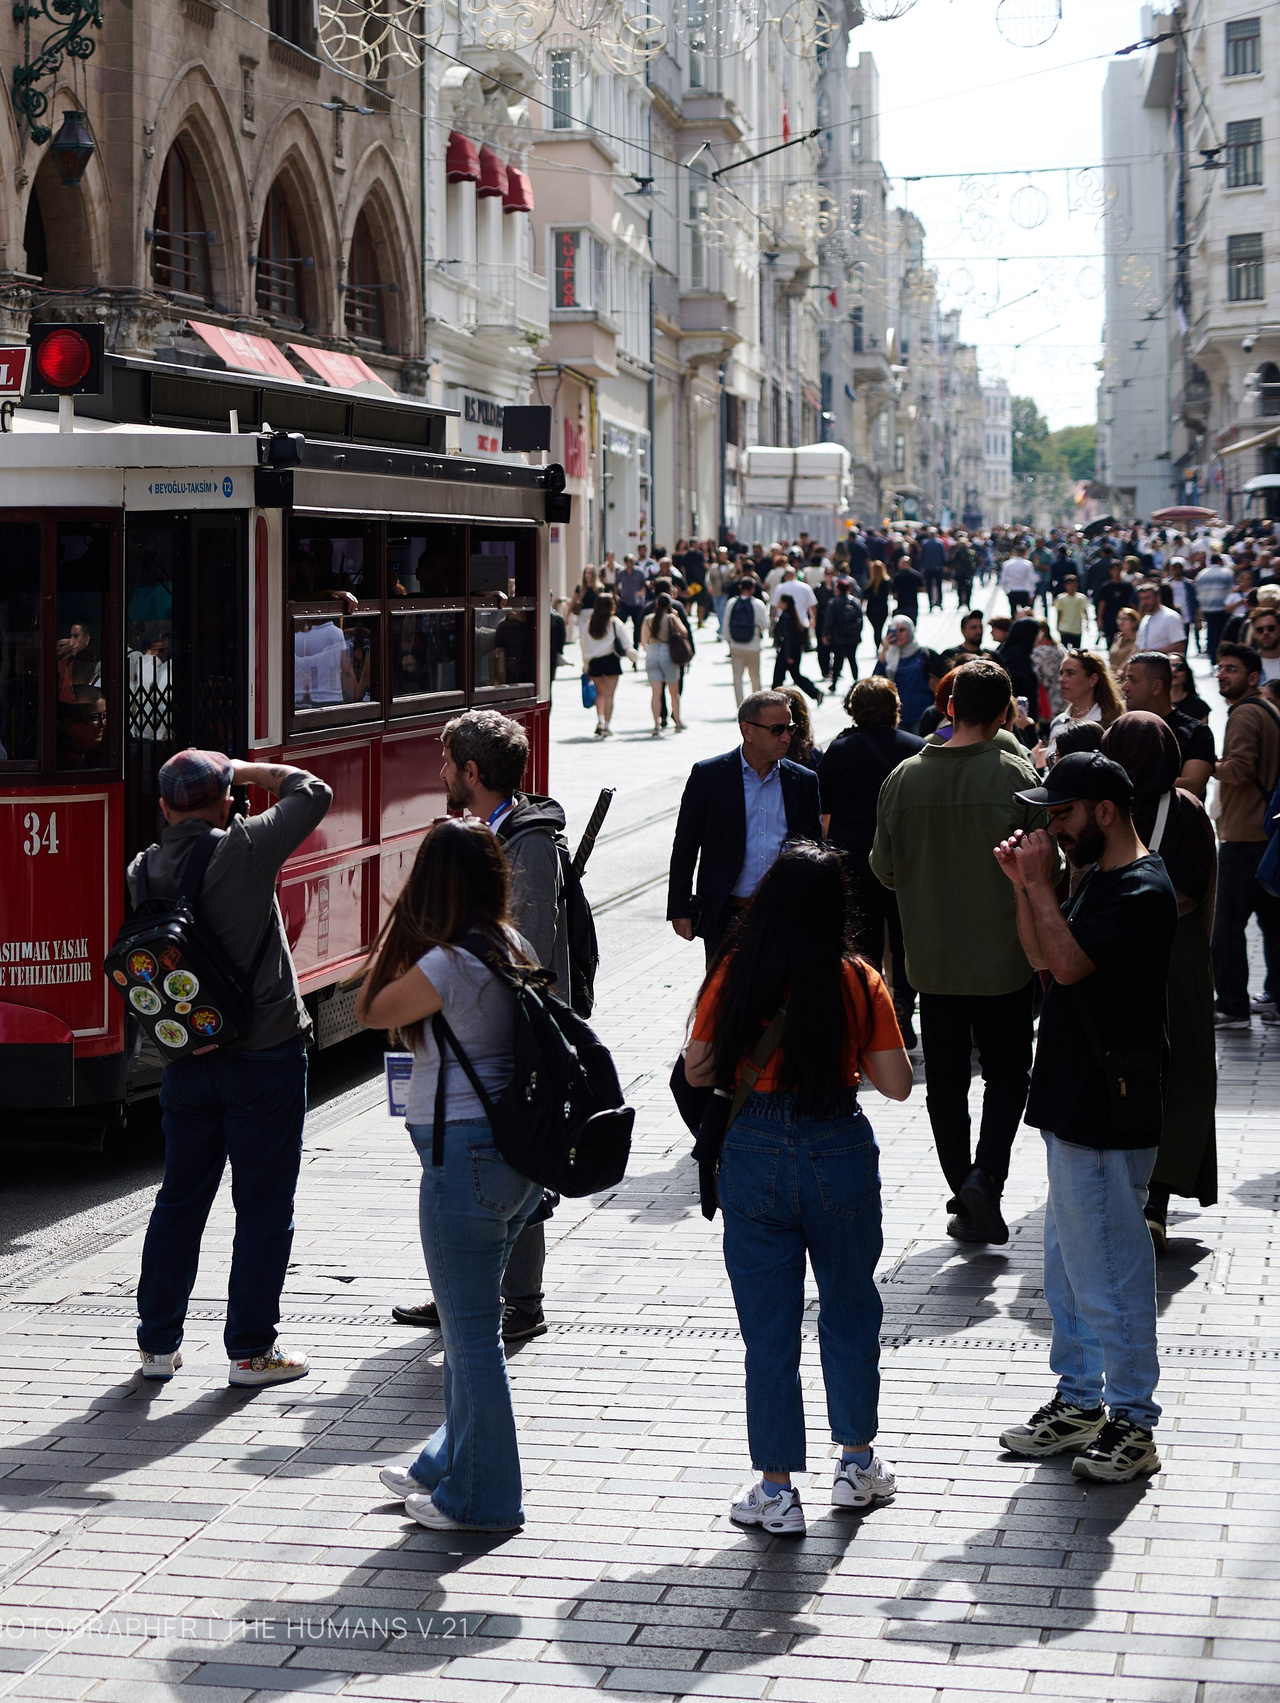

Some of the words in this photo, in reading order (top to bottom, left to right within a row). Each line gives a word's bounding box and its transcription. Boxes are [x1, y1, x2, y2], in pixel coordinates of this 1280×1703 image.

[154, 480, 212, 494] BEYOĞLU-TAKSİM
[223, 482, 232, 492] T2
[23, 811, 60, 856] 34
[52, 938, 89, 960] YASAK
[8, 961, 92, 986] TEHLIKELIDIR
